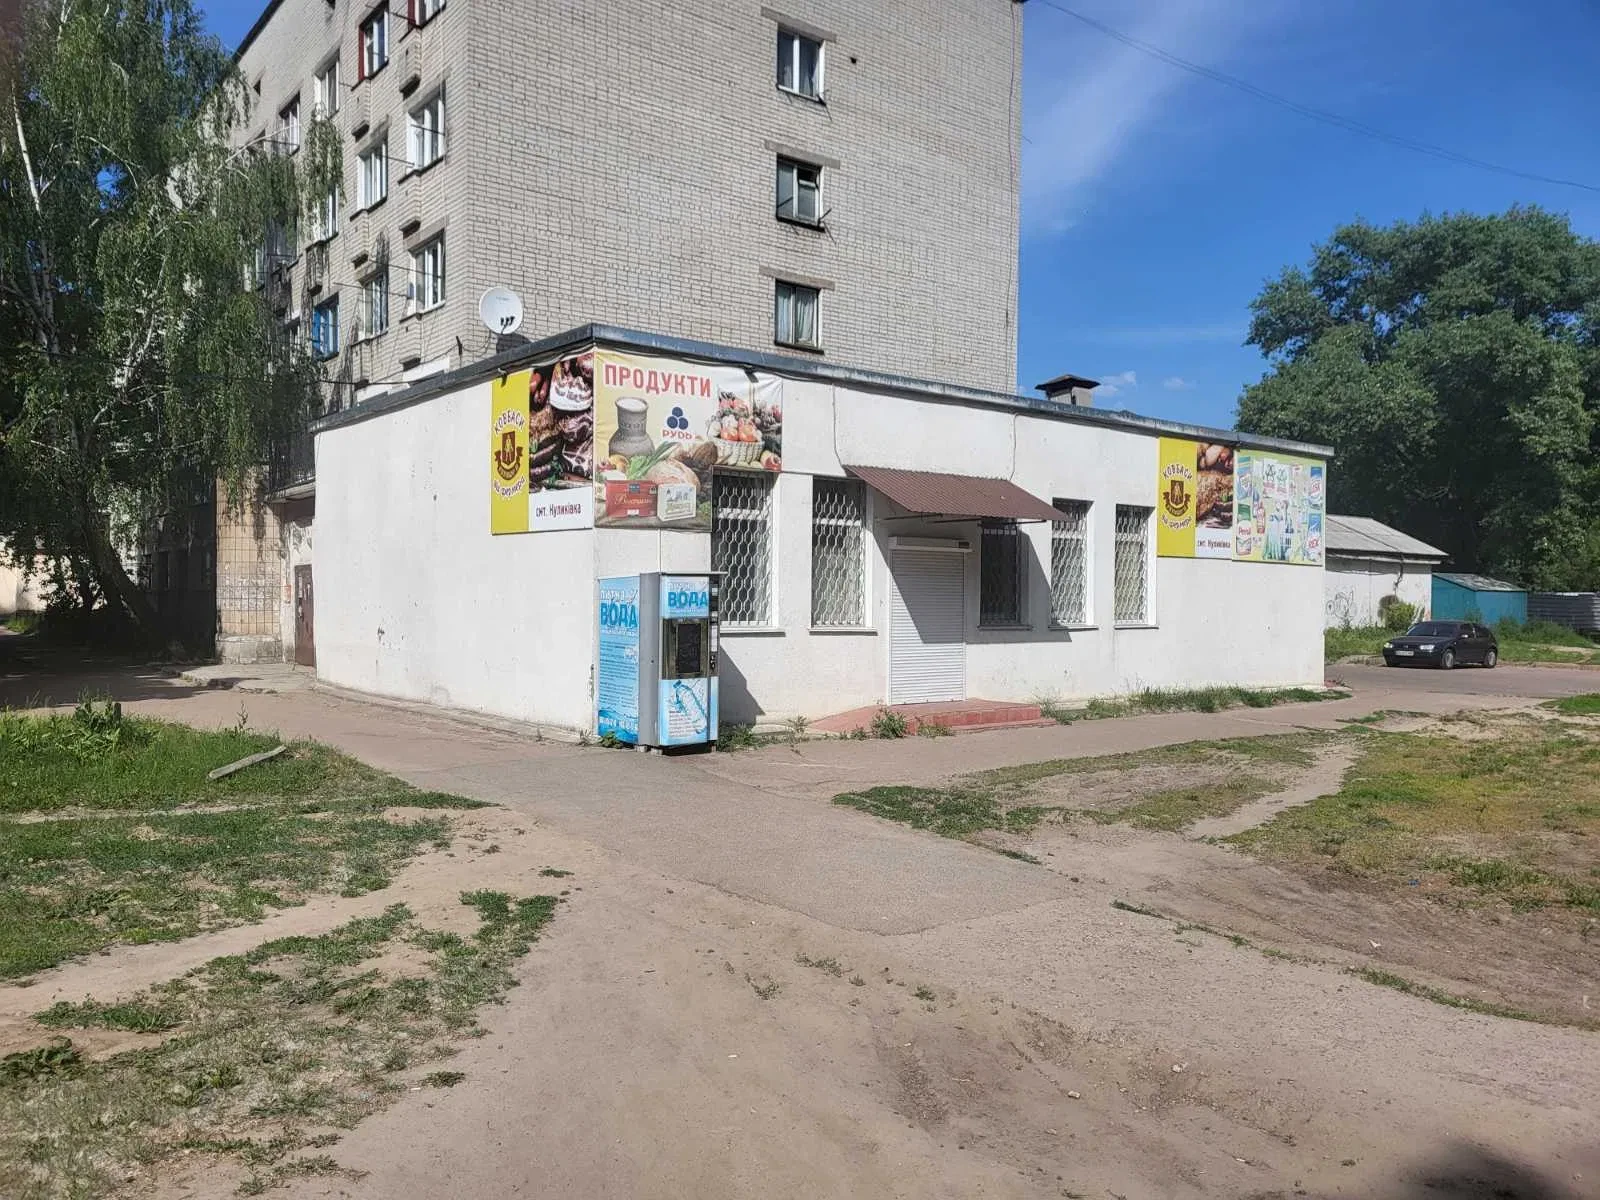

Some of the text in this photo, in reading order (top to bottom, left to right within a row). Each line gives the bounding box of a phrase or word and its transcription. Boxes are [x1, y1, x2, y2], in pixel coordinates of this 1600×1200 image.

[604, 363, 712, 398] ПРОДУКТИ
[494, 410, 526, 434] КОВБАСИ
[668, 590, 708, 608] ВОДА
[600, 601, 637, 627] ВОДА
